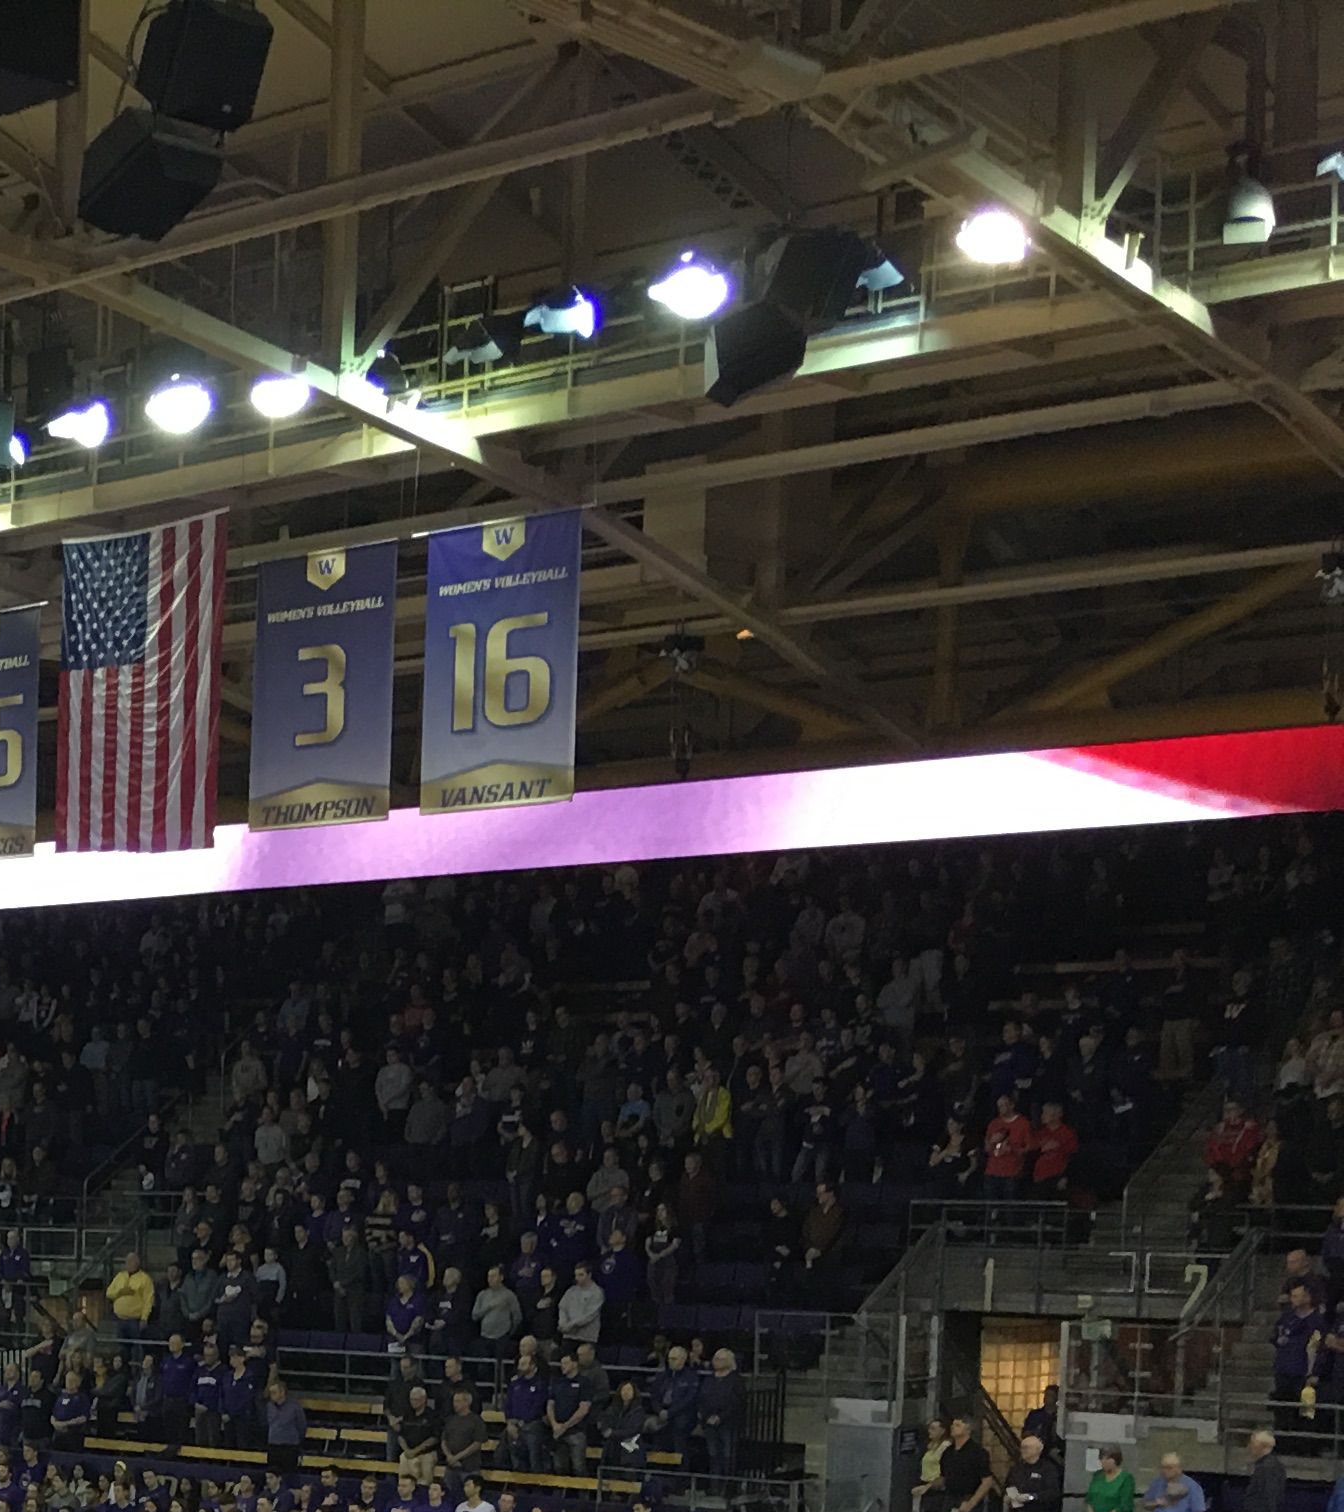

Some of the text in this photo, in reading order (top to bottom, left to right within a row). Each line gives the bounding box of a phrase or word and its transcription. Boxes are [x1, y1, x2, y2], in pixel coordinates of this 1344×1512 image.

[494, 527, 515, 545] W
[317, 558, 336, 576] W
[494, 567, 568, 589] VOLLEYBALL
[316, 596, 384, 617] VOLLEYBALL
[448, 611, 551, 733] 16
[294, 644, 346, 747] 3
[440, 778, 552, 808] VANSANT
[261, 797, 375, 825] THOMPSON
